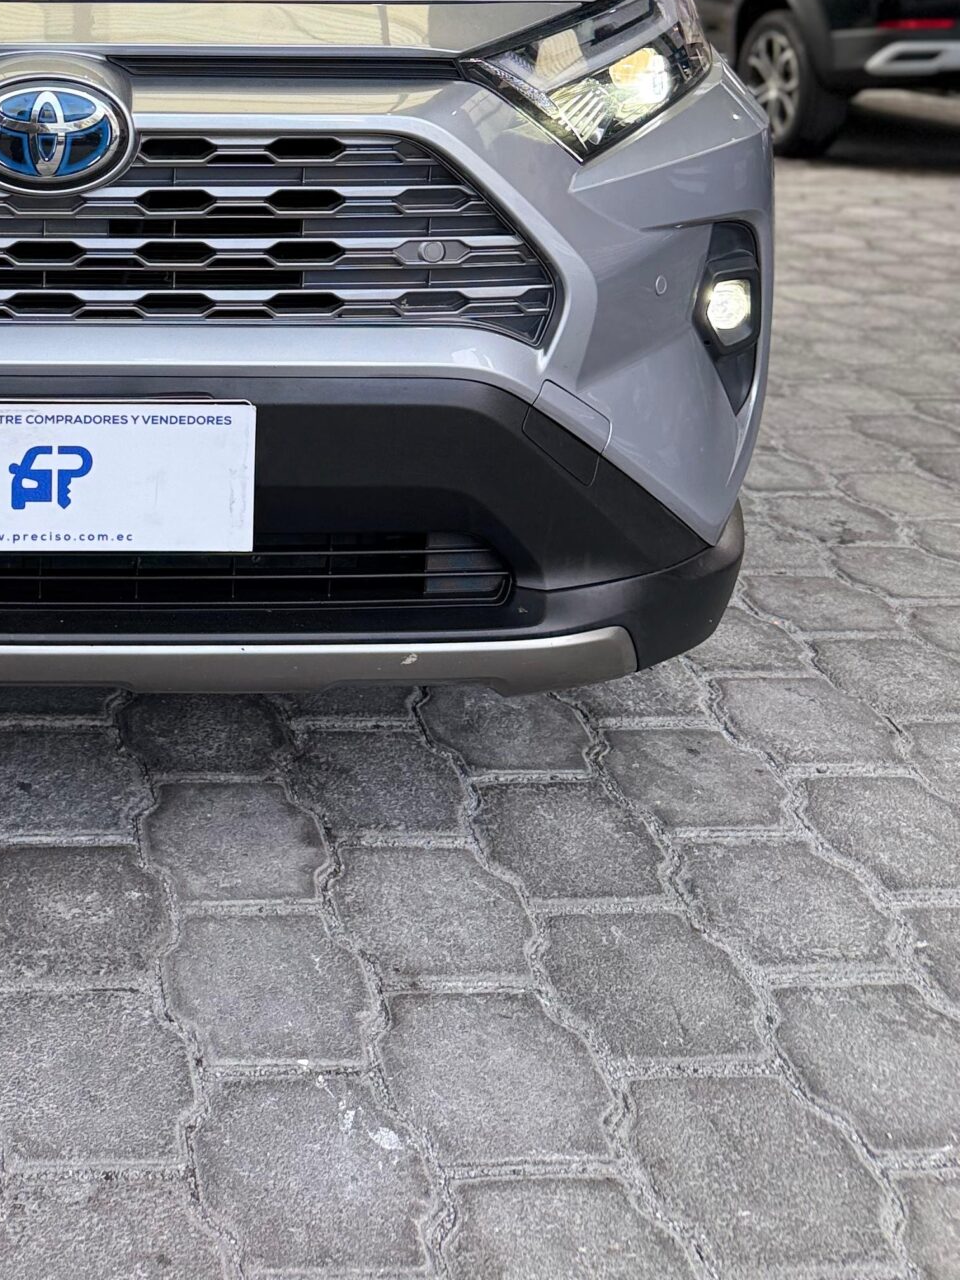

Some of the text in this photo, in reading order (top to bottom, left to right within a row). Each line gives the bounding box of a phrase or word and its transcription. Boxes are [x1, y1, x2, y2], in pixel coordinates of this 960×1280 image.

[25, 414, 129, 425] COMPRADORES
[130, 414, 140, 425] Y
[141, 415, 232, 426] VENDEDORES
